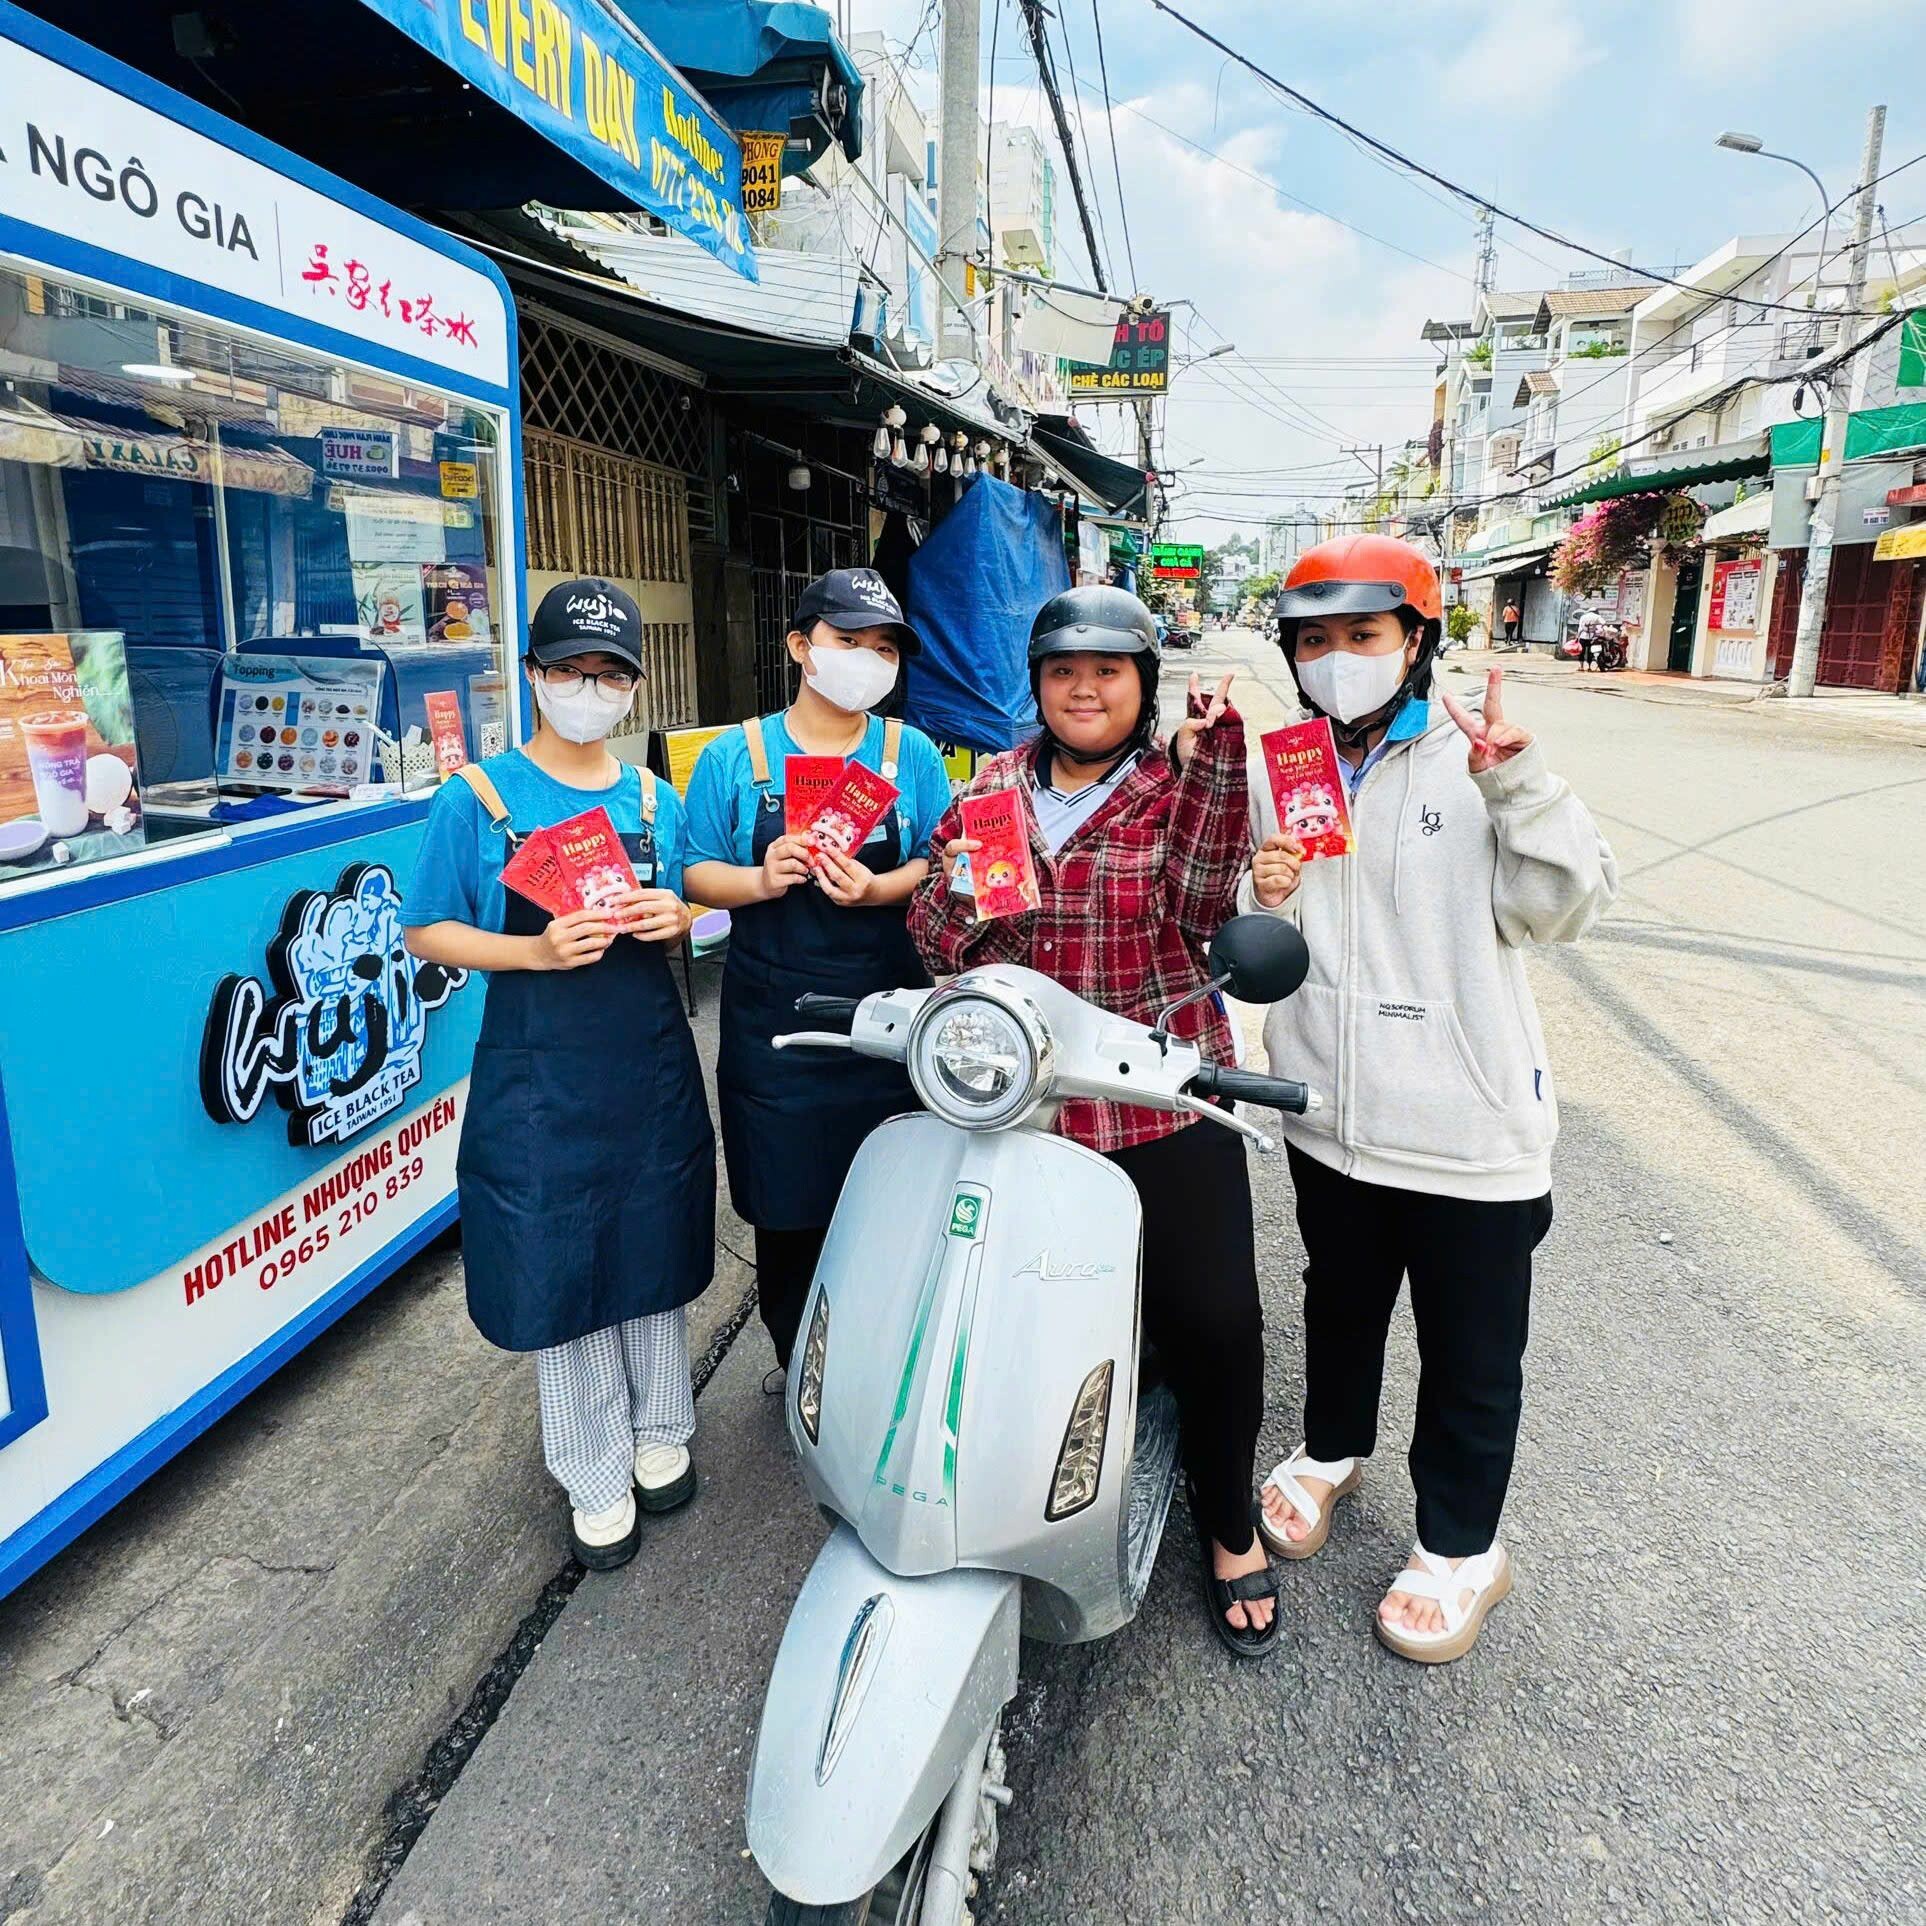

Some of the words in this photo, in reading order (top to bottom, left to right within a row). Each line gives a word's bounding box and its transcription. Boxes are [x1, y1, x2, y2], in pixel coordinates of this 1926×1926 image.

[581, 31, 641, 172] DAY
[662, 84, 725, 186] Hotline:
[651, 136, 686, 212] 0777
[26, 121, 158, 218] NGÔ
[176, 191, 259, 261] GIA
[1136, 316, 1165, 342] TỐ
[1137, 346, 1165, 368] ÉP
[1072, 372, 1099, 388] CHÈ
[1102, 372, 1130, 387] CÁC
[1133, 372, 1164, 389] LOẠI
[586, 619, 609, 628] BLACK
[233, 664, 276, 679] Topping
[1276, 747, 1322, 766] Happy
[795, 776, 834, 789] Happy
[844, 781, 879, 812] Happy
[973, 813, 1012, 830] Happy
[562, 832, 607, 857] Happy
[1378, 1010, 1425, 1021] MINIMALIST
[318, 1110, 342, 1135] ICE
[346, 1081, 390, 1118] BLACK
[392, 1067, 416, 1089] TEA
[346, 1106, 377, 1130] TAIWAN
[380, 1094, 396, 1110] 1951
[184, 1204, 297, 1305] HOTLINE
[303, 1140, 393, 1224] NHƯỢNG
[259, 1224, 330, 1291] 0965
[338, 1191, 378, 1237] 210
[385, 1157, 424, 1200] 839
[951, 1222, 975, 1236] PEGA
[1011, 1247, 1099, 1281] Aura
[876, 1475, 949, 1507] PEGA
